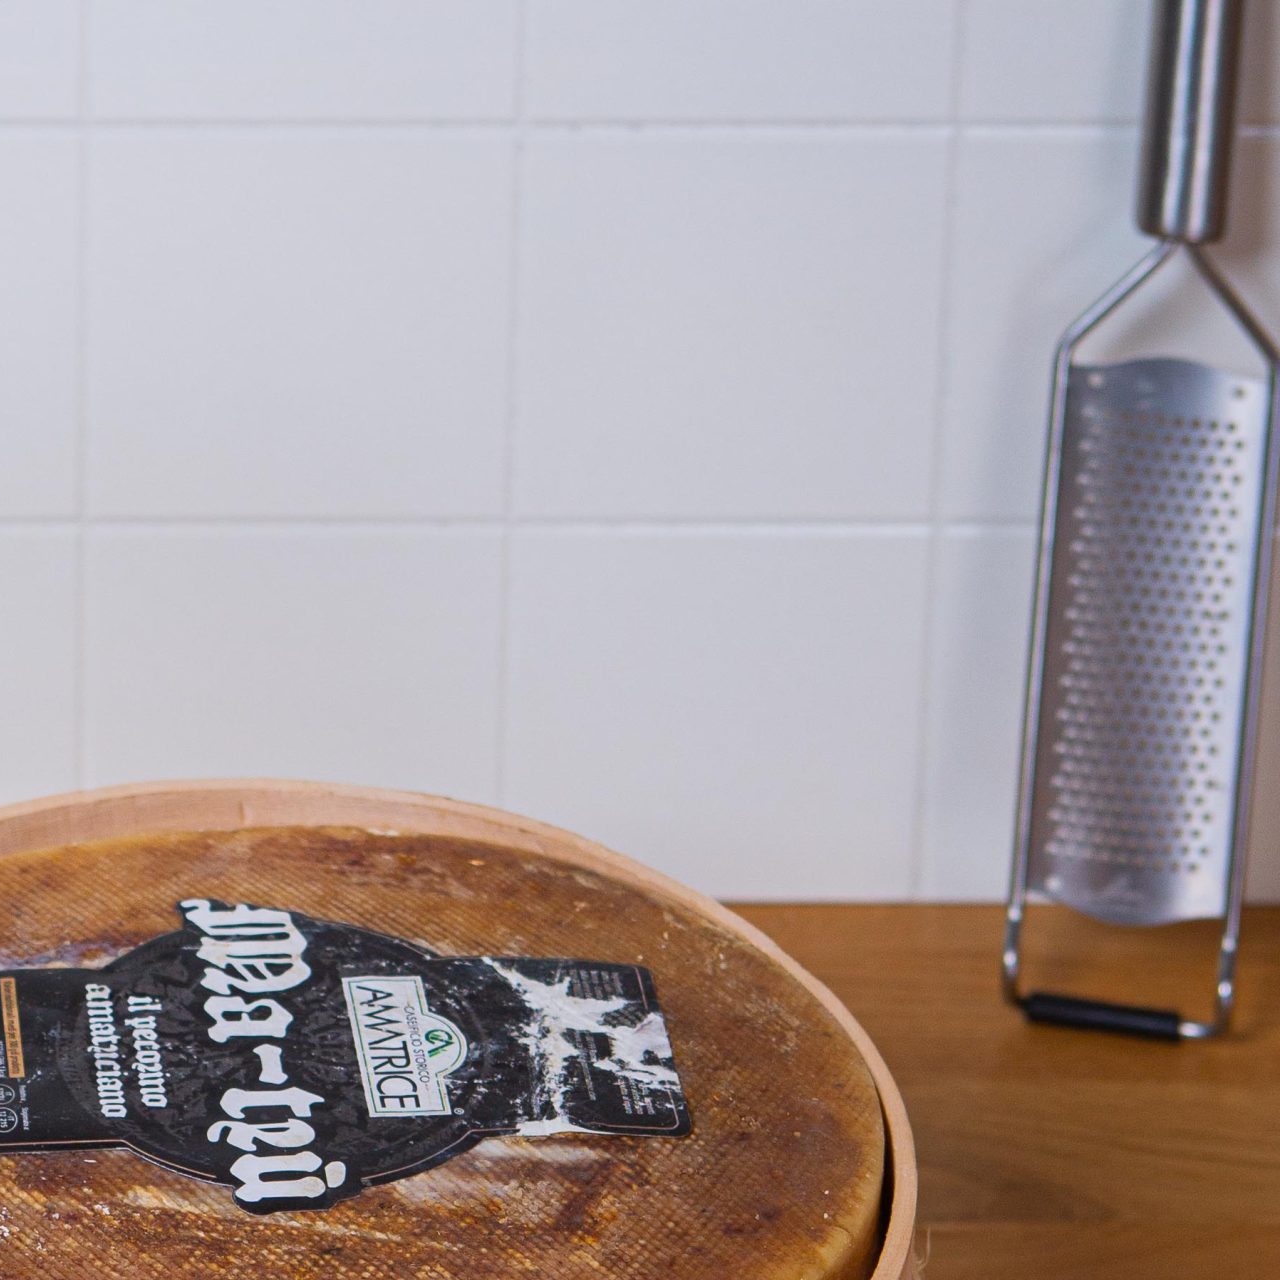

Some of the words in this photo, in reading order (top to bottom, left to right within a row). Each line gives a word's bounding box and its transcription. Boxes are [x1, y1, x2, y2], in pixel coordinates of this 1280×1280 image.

[127, 996, 162, 1012] il
[404, 1006, 423, 1047] CASEIFICIO
[83, 983, 128, 1118] amatriciano
[124, 1015, 171, 1108] pecorino
[356, 985, 420, 1108] AMATRICE
[413, 1049, 431, 1083] STORICO
